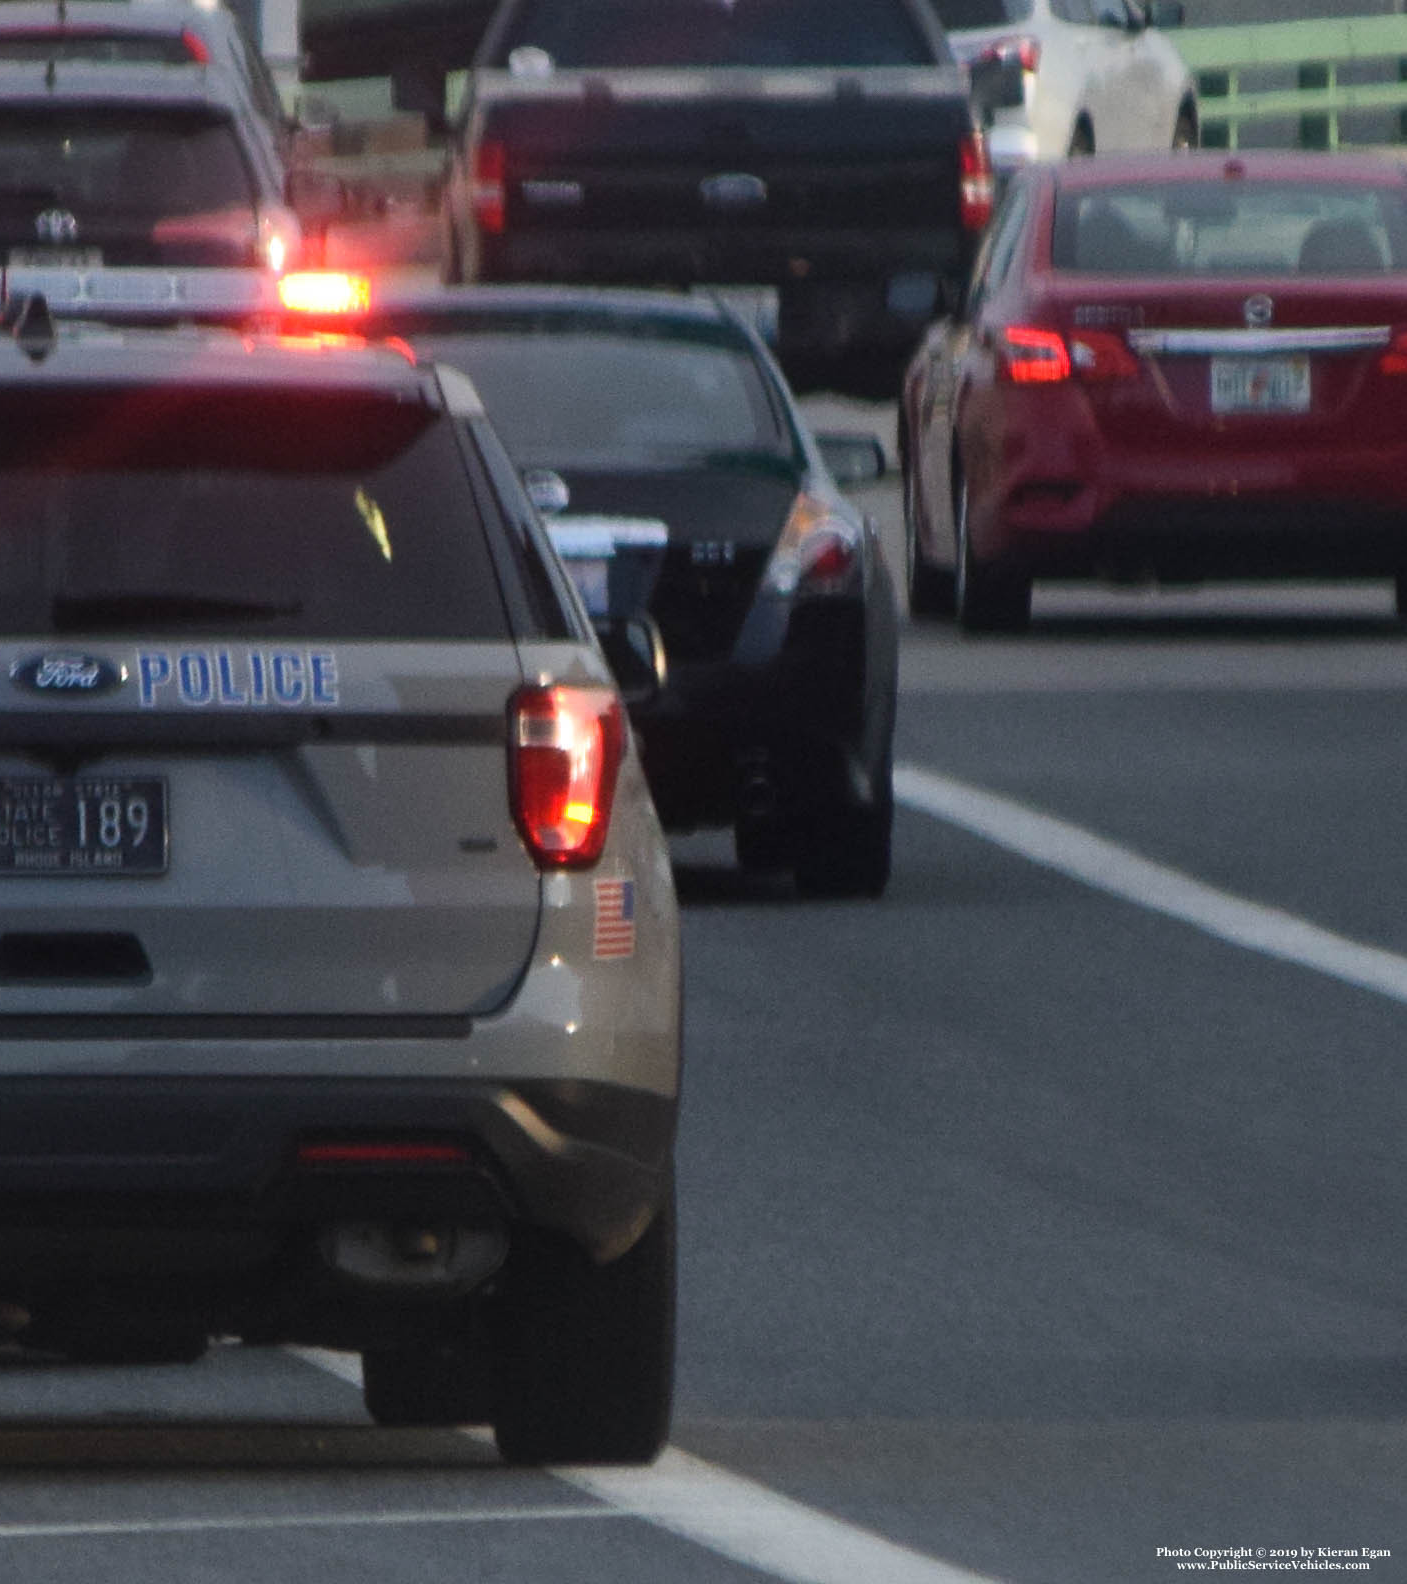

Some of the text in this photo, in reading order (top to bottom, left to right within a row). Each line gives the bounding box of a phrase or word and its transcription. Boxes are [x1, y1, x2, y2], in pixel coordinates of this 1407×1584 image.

[36, 657, 99, 688] Ford
[137, 647, 339, 707] POLICE
[78, 798, 149, 848] 189
